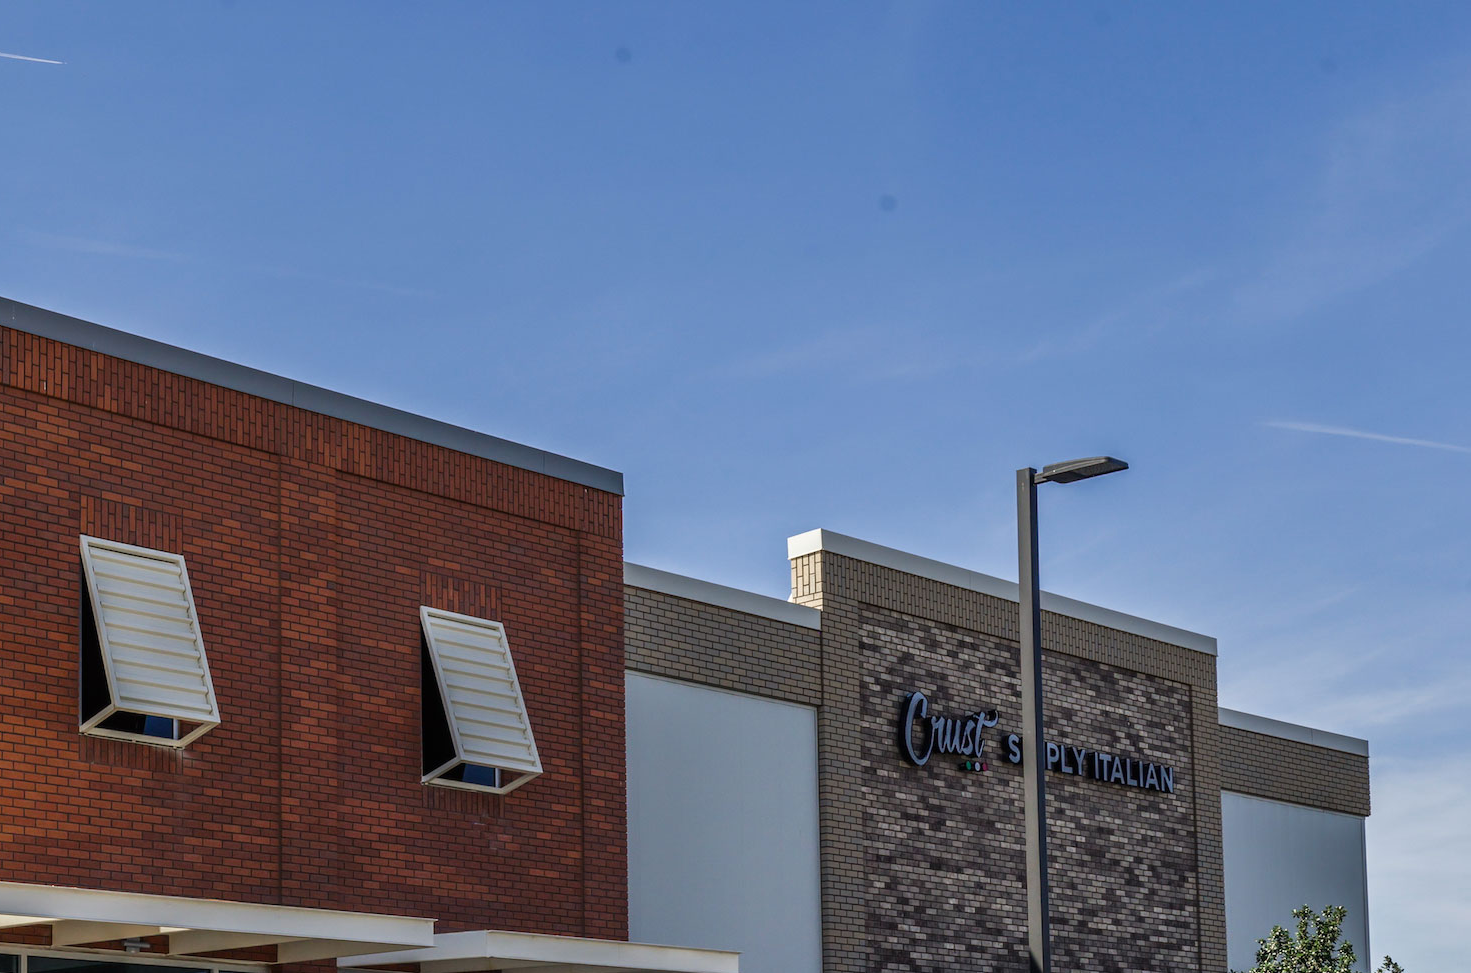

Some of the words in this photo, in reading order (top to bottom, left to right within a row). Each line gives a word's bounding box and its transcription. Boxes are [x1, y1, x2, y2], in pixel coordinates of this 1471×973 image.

[903, 691, 1000, 767] Crust
[1008, 734, 1086, 775] SPLY
[1094, 752, 1174, 793] ITALIAN
